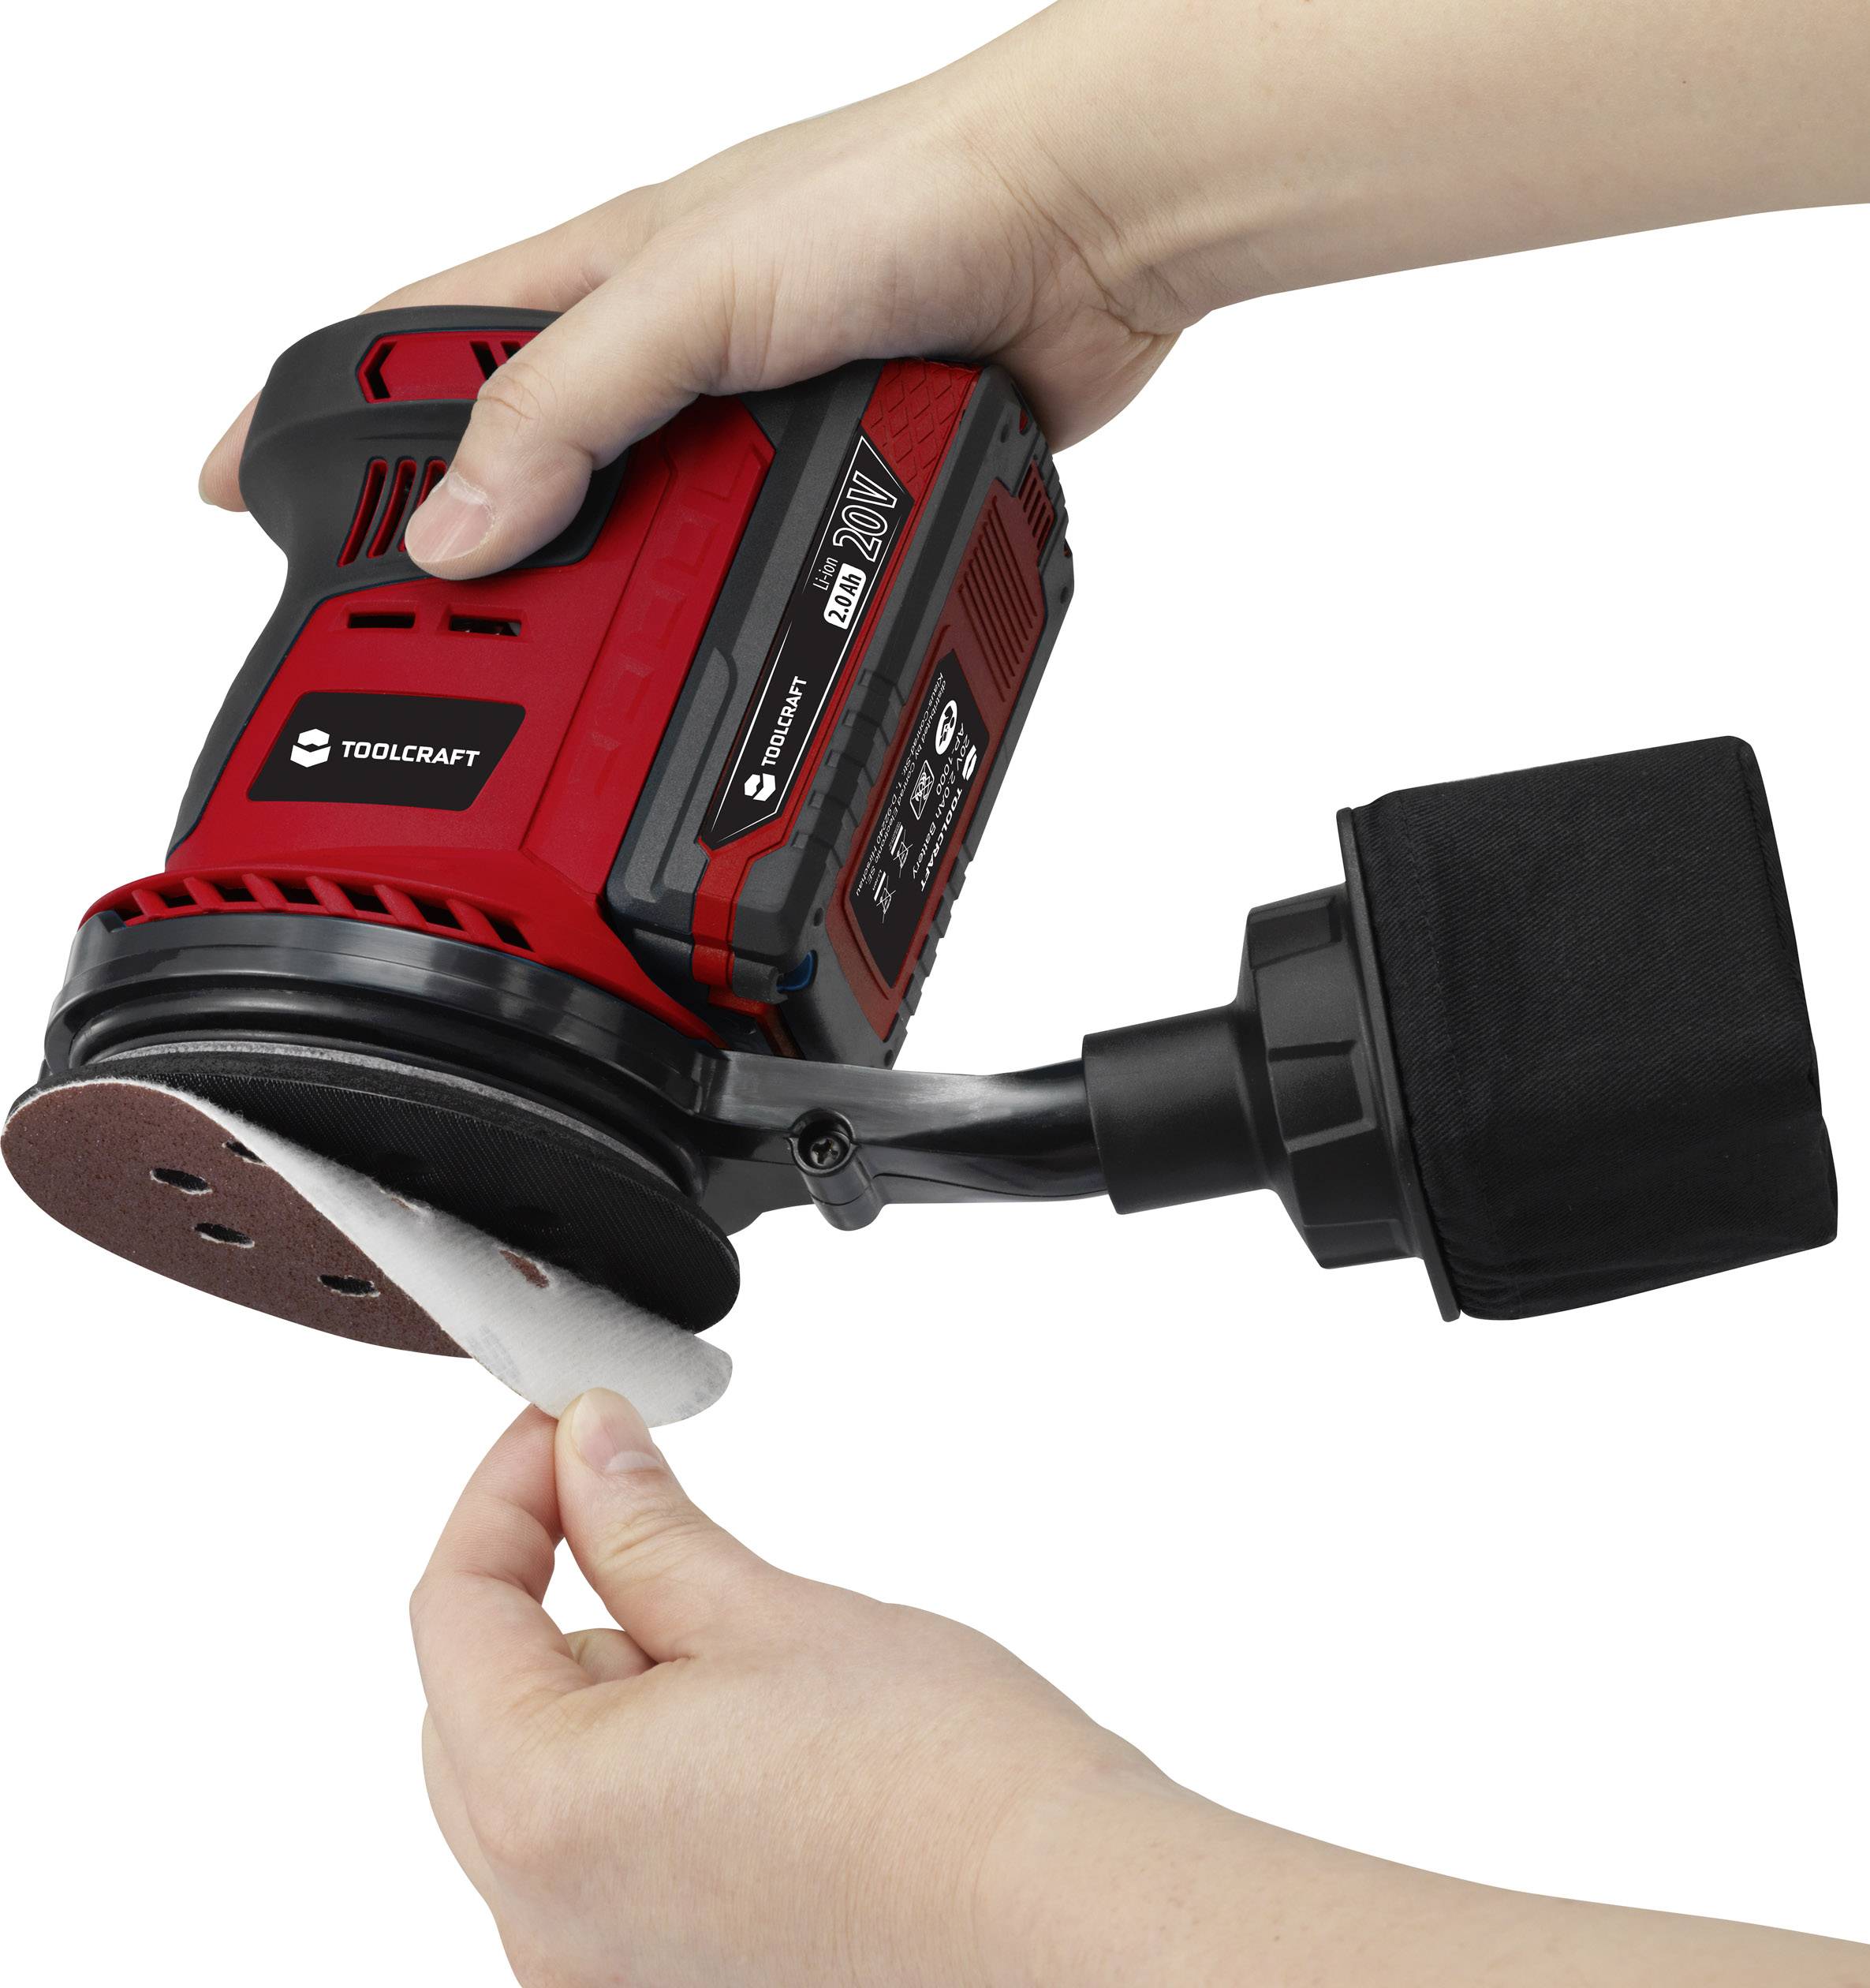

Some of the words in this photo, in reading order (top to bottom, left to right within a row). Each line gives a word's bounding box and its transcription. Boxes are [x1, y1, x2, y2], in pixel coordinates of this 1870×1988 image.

[832, 469, 898, 562] 20V
[812, 557, 838, 591] Li-ion
[839, 572, 863, 597] Ah
[828, 595, 852, 623] 2.0
[761, 675, 808, 767] TOOLCRAFT
[901, 672, 943, 775] Klaus-Conrad-Str.
[920, 680, 946, 744] distributed
[342, 740, 481, 767] TOOLCRAFT
[914, 743, 923, 760] by
[936, 722, 964, 796] AP-1000
[956, 734, 970, 772] 20V
[898, 761, 916, 805] Conrad
[935, 770, 956, 819] 2.0Ah
[874, 806, 898, 864] Electronic
[876, 793, 898, 845] D-92240
[920, 787, 963, 892] TOOLCRAFT
[856, 845, 878, 896] Hirschau
[913, 821, 936, 880] Battery
